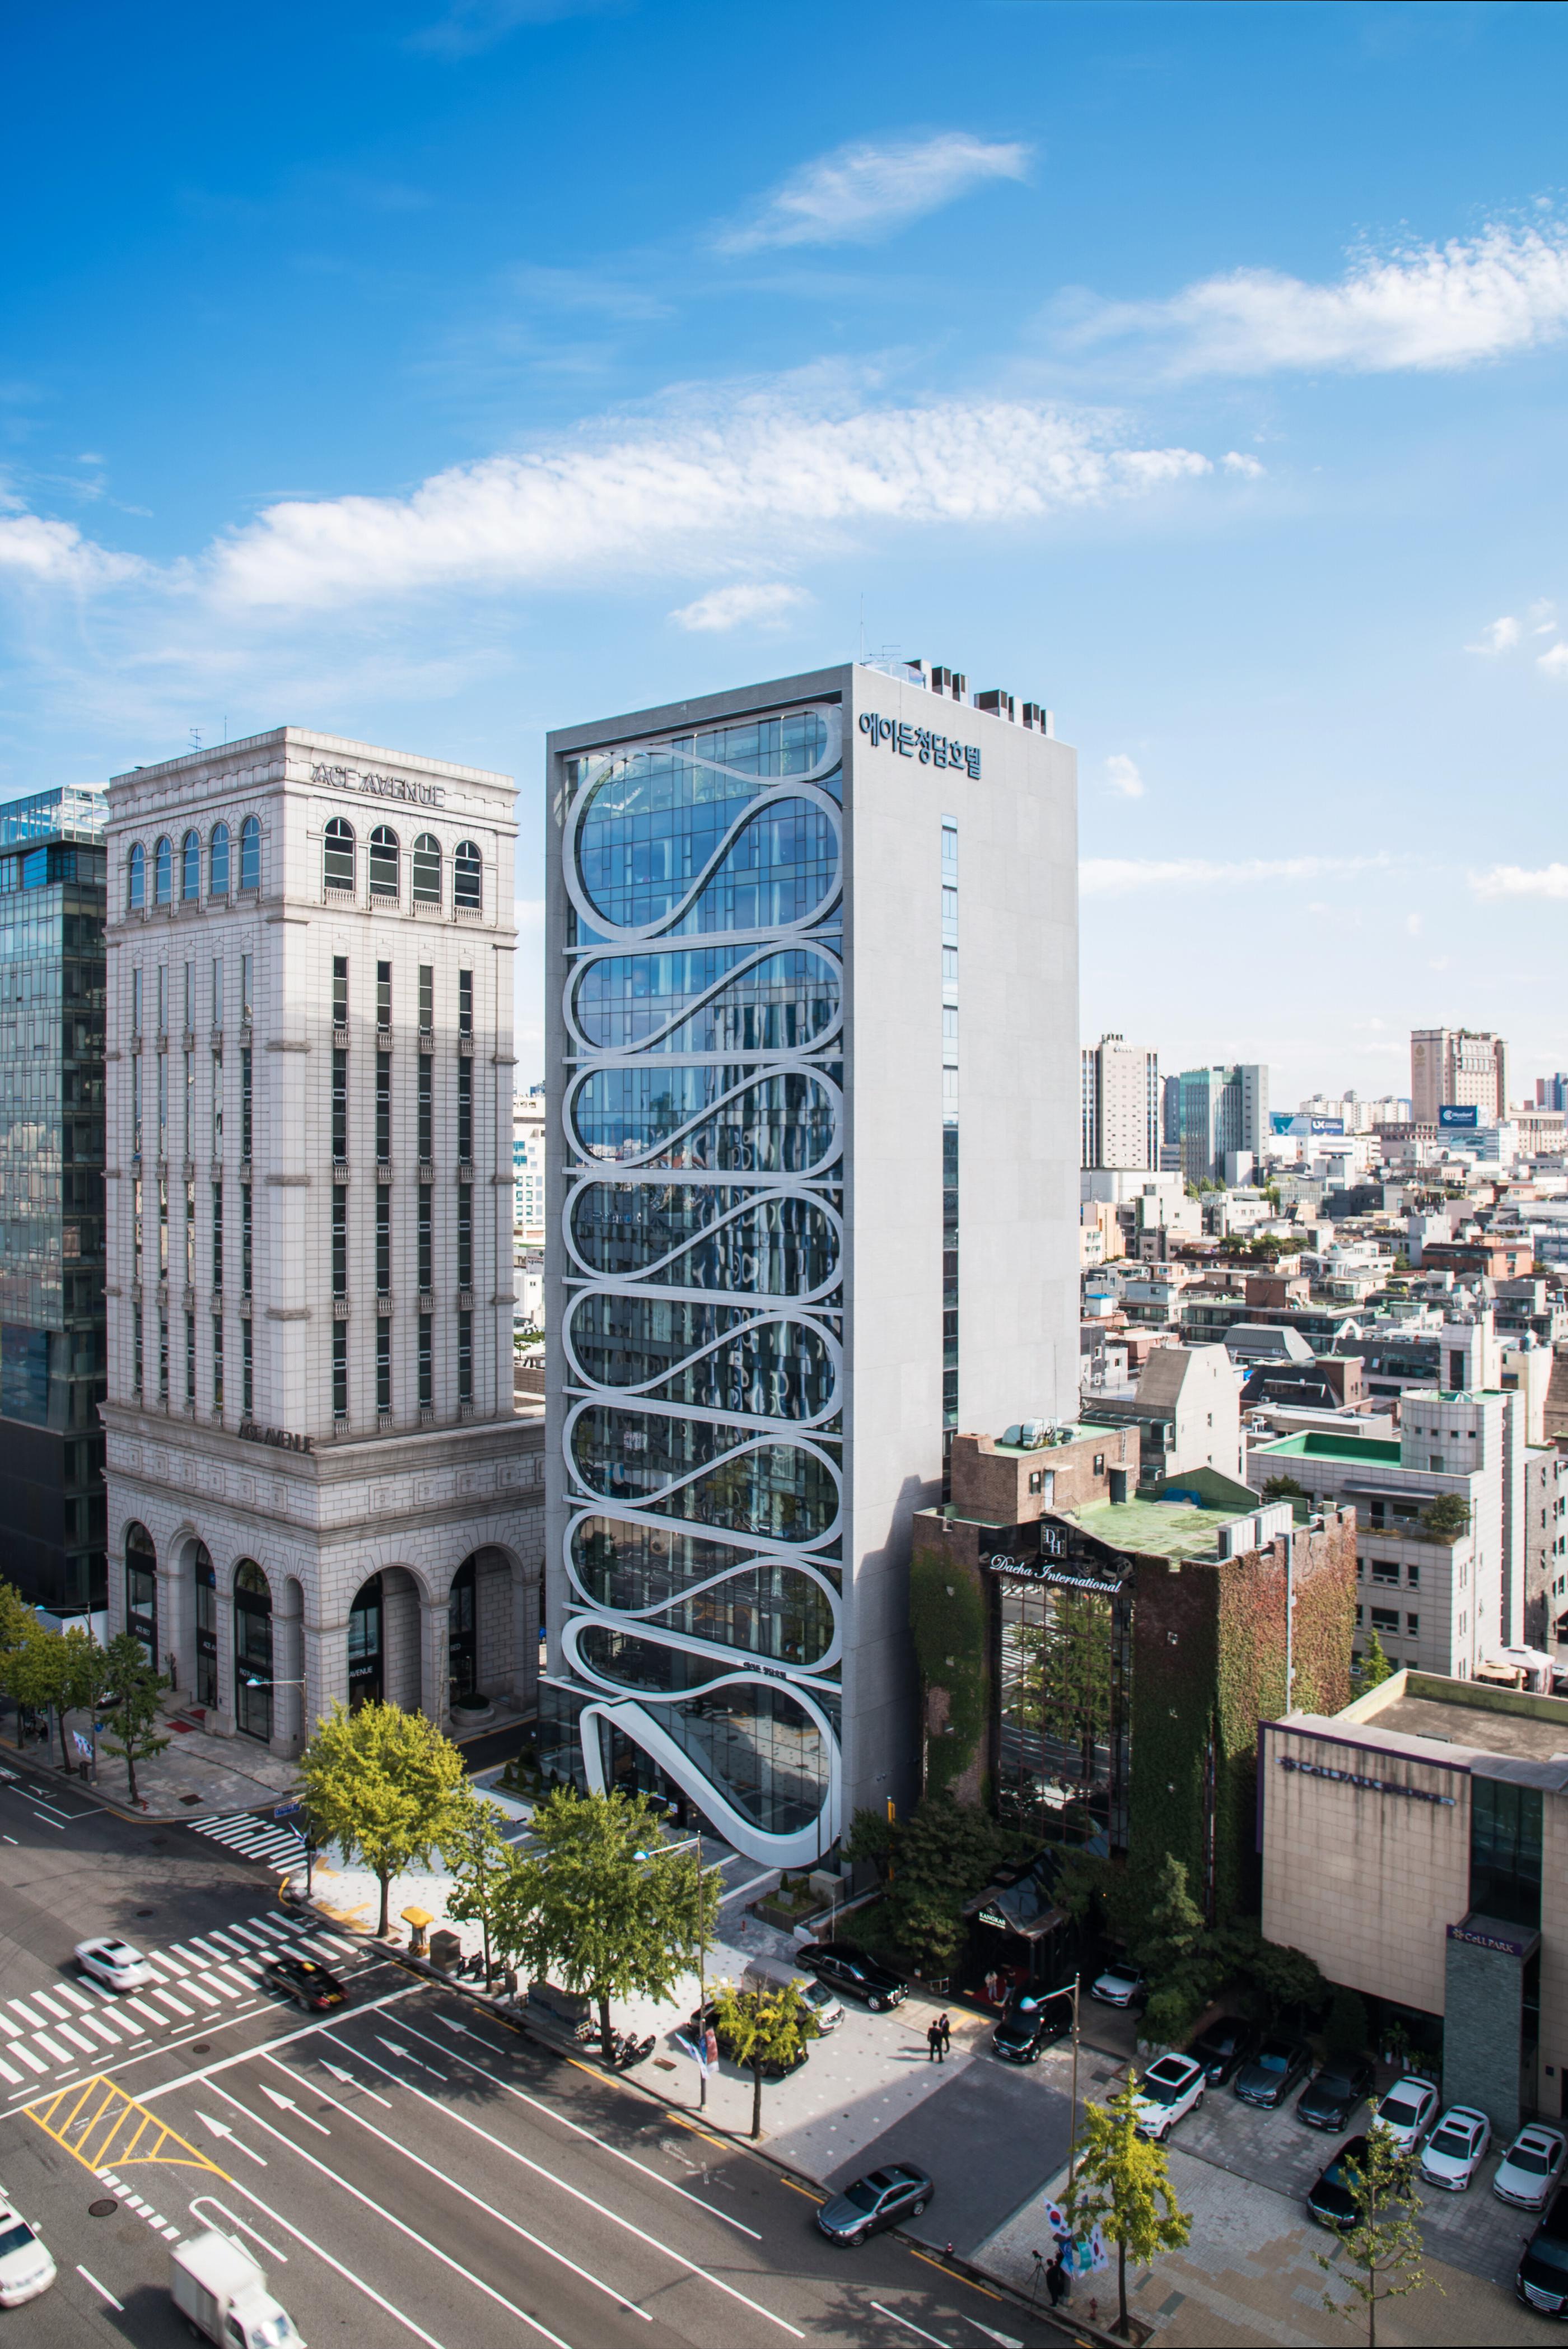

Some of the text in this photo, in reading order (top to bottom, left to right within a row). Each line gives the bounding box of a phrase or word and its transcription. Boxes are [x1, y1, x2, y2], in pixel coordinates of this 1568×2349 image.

[859, 712, 982, 780] 에이든청담호텔
[312, 762, 446, 808] ACE AVENUE
[264, 1427, 316, 1456] AVENUE
[990, 1554, 1123, 1593] Daeha International
[349, 1666, 373, 1678] AVENUE
